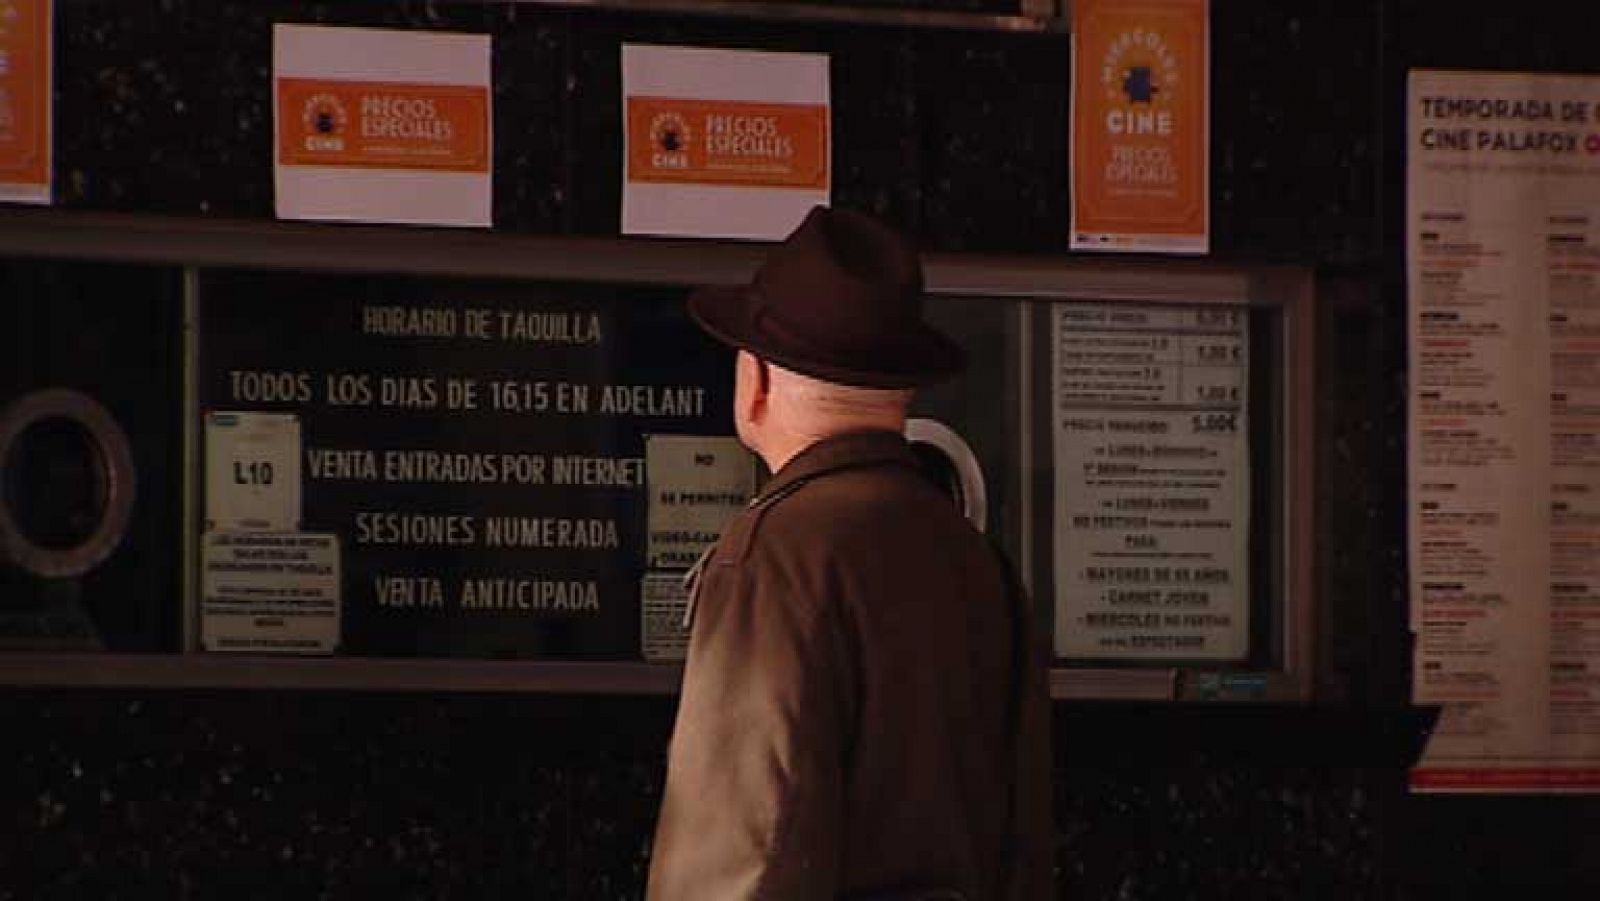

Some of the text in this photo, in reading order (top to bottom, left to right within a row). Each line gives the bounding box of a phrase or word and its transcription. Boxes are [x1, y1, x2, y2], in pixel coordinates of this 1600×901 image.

[361, 96, 436, 118] PRECIOS
[1421, 97, 1588, 122] TEMPORADA DE
[361, 117, 452, 139] ESPECIALES
[706, 114, 779, 136] PRECIOS
[1106, 111, 1175, 134] CINE
[305, 136, 345, 151] CINE
[706, 136, 793, 158] ESPECIALES
[1421, 129, 1470, 151] CINE
[1477, 130, 1577, 152] PALAFOX
[652, 153, 689, 168] CINE
[363, 305, 602, 344] HORARIO DE TAQUILLA
[231, 370, 311, 402] TODOS
[328, 375, 370, 406] LOS
[381, 377, 437, 408] DIAS
[447, 380, 478, 410] DE
[558, 384, 589, 414] EN
[601, 387, 706, 417] ADELANT
[309, 449, 646, 487] VENTA ENTRADAS POR INTERNET
[694, 453, 715, 467] NO
[356, 513, 618, 549] SESIONES NUMERADA
[375, 575, 444, 609] VENTA
[462, 578, 600, 612] ANTICIPADA
